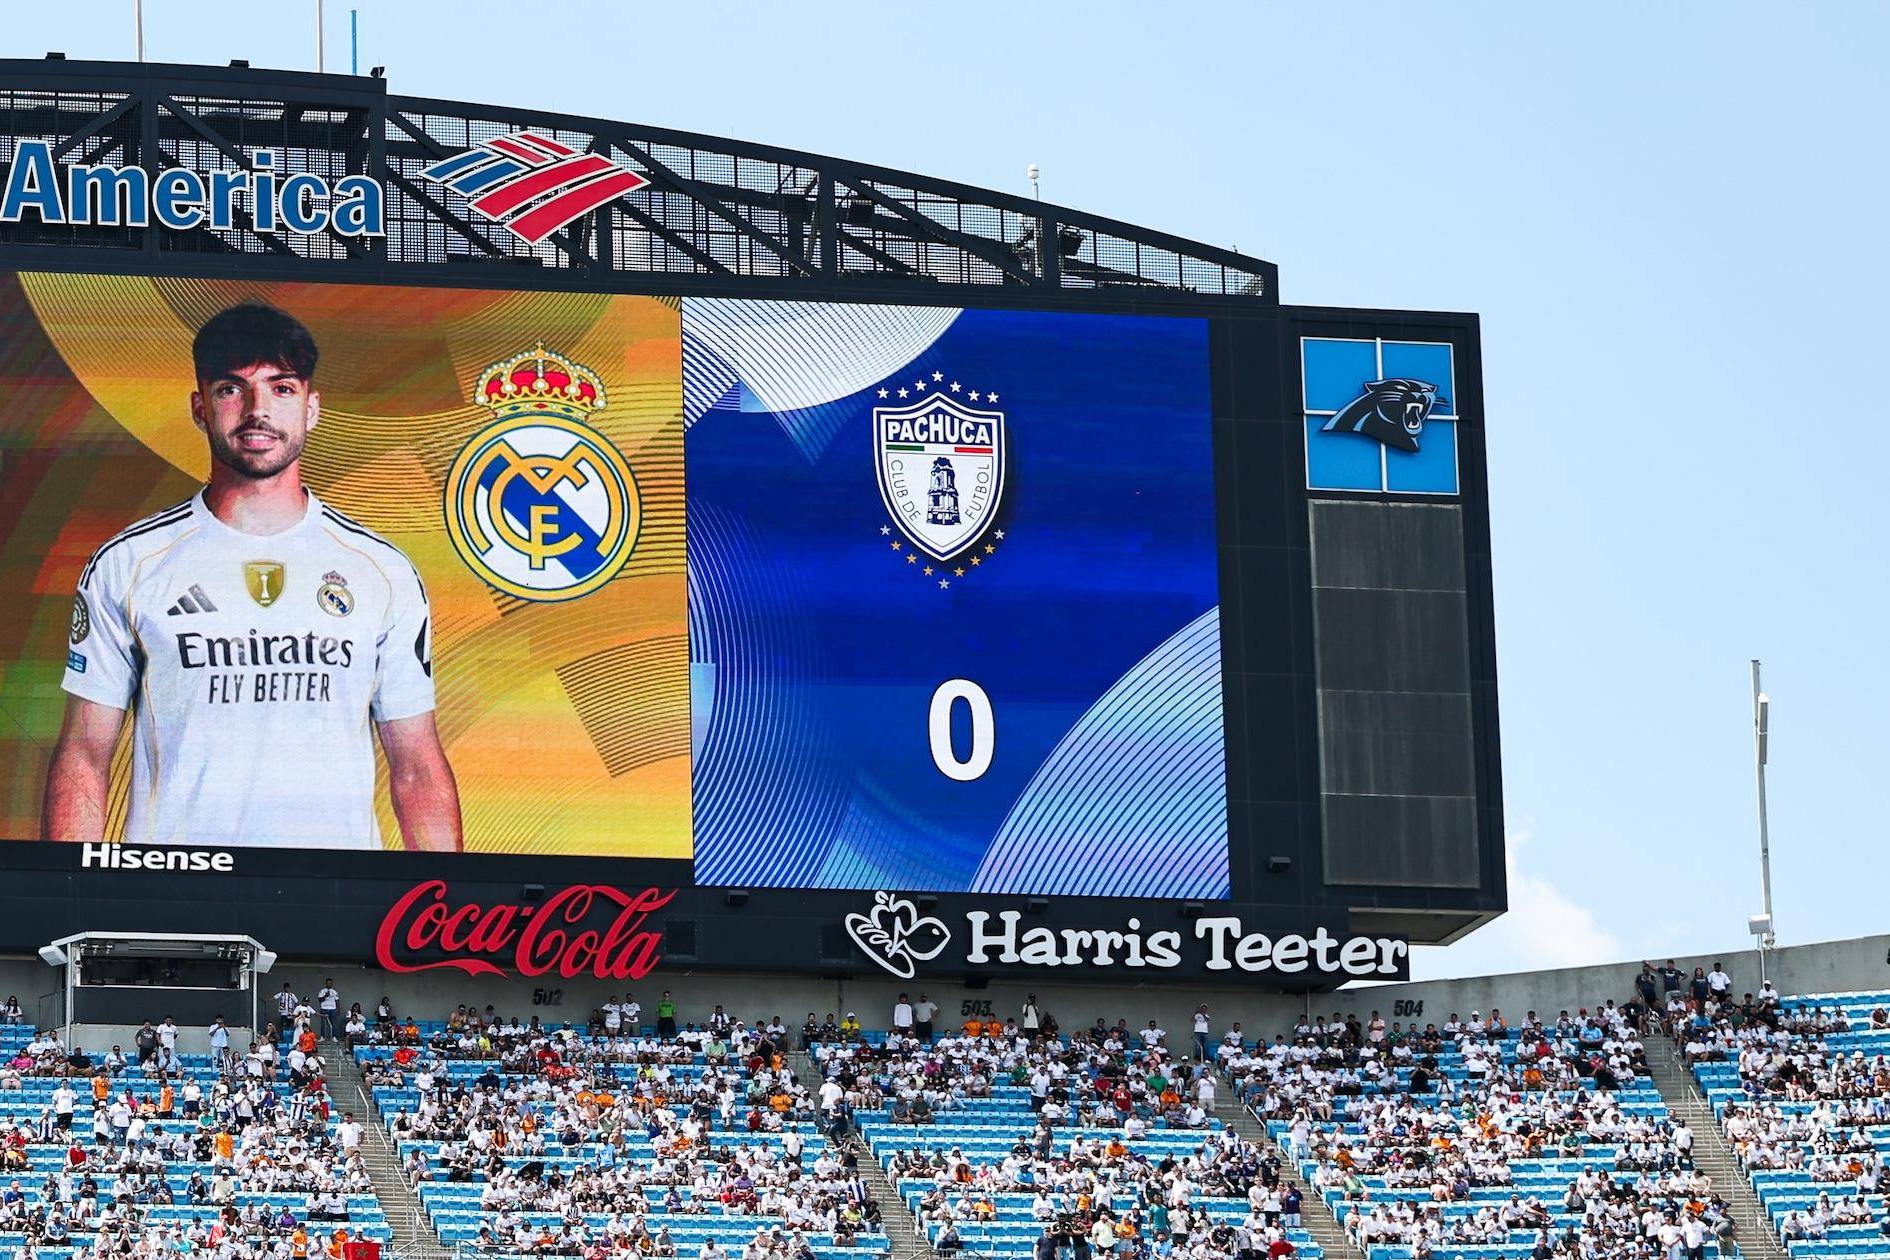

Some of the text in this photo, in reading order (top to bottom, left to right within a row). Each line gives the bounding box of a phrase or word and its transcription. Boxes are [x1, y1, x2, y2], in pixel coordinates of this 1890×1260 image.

[1, 138, 387, 239] America
[887, 413, 992, 445] PACHUCA
[890, 459, 922, 522] CLUB DE
[964, 463, 991, 520] FUTBOL
[175, 628, 354, 670] Emirates
[208, 672, 331, 704] FLY BETTER
[928, 678, 996, 783] 0
[81, 841, 235, 873] Hisense
[374, 879, 678, 980] Coca-Cola
[965, 909, 1408, 975] Harris Teeter
[532, 988, 564, 1006] 502
[961, 999, 994, 1016] 503
[1393, 1000, 1425, 1018] 504
